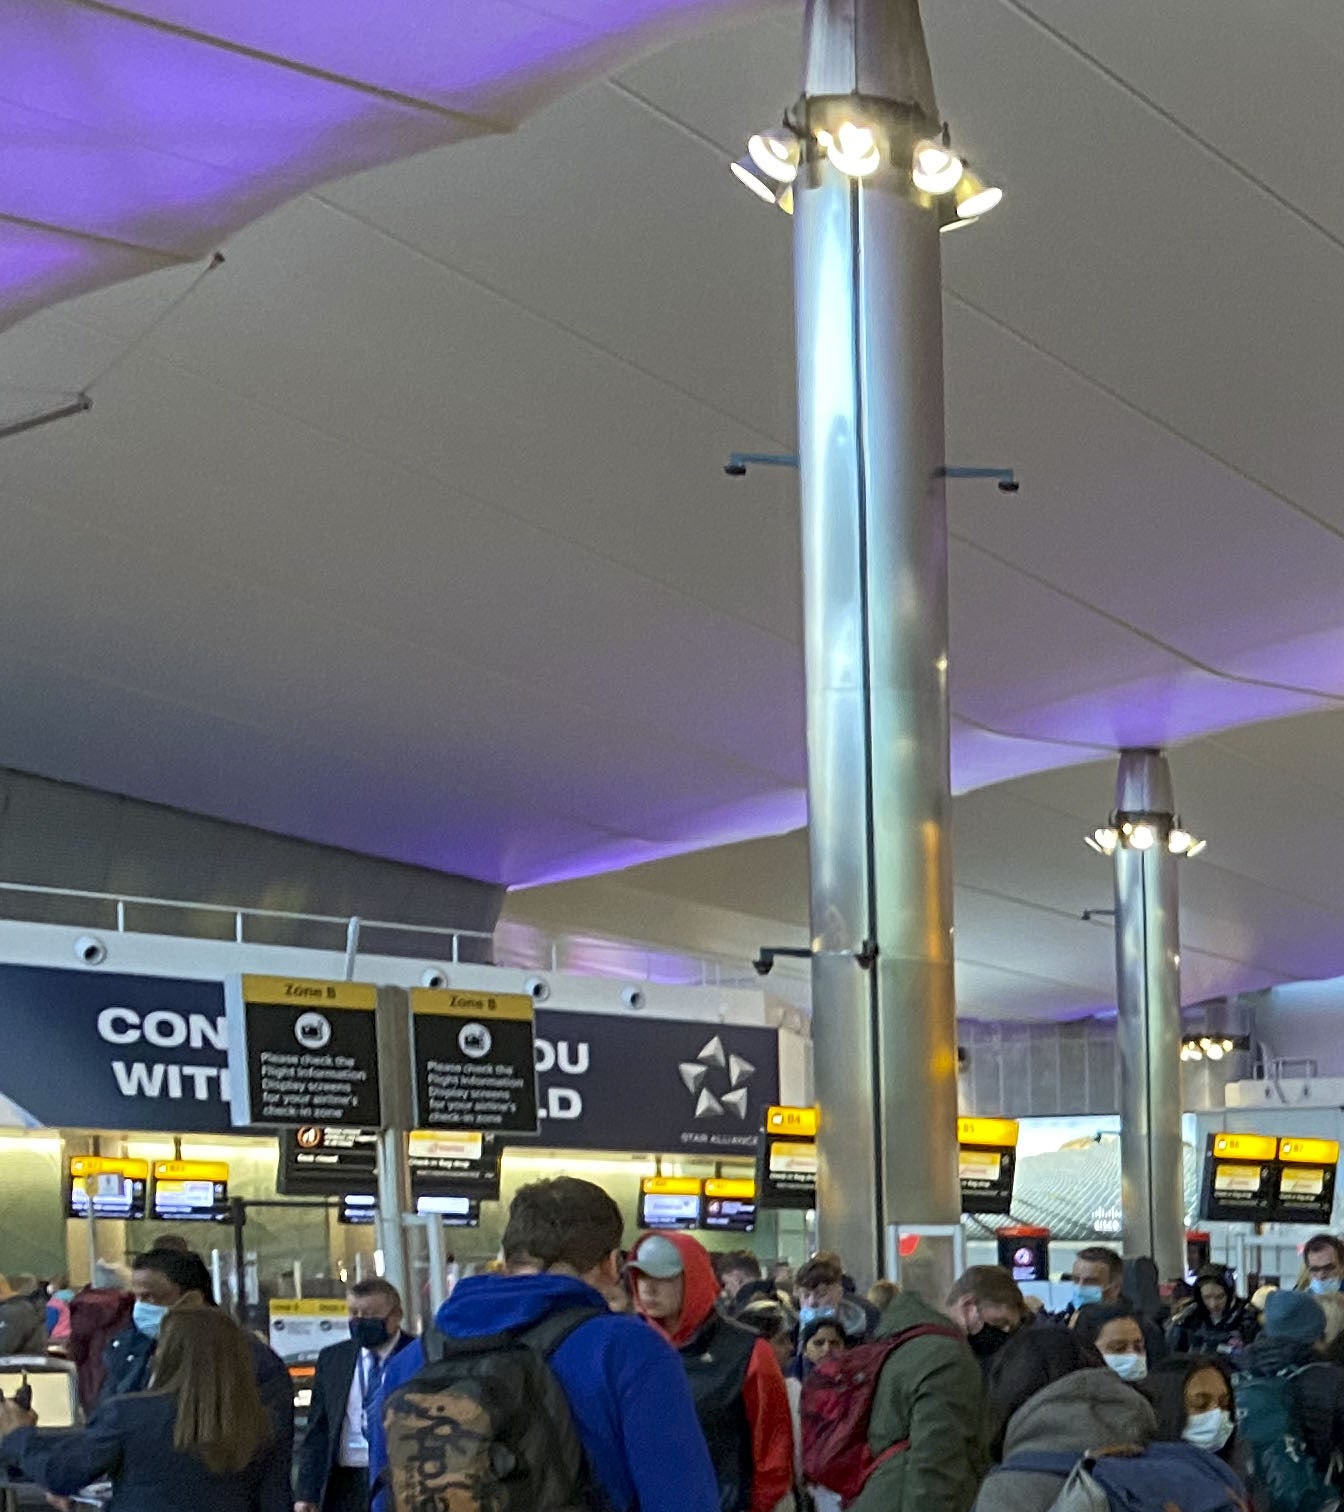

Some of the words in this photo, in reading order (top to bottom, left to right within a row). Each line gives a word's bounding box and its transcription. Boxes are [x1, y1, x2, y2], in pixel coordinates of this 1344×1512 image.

[284, 983, 323, 997] Zone
[450, 995, 484, 1010] Zone
[97, 1006, 228, 1050] CON
[261, 1051, 298, 1065] Please
[300, 1052, 334, 1066] check
[335, 1053, 355, 1067] the
[427, 1060, 462, 1073] Please
[463, 1061, 493, 1074] check
[495, 1062, 514, 1075] the
[307, 1081, 351, 1093] screens
[470, 1088, 510, 1100] screens
[263, 1092, 280, 1104] for
[282, 1094, 311, 1106] your
[429, 1098, 445, 1111] for
[447, 1101, 473, 1113] your
[263, 1105, 312, 1118] check-in
[314, 1107, 344, 1119] zone
[429, 1112, 473, 1123] check-in
[475, 1113, 502, 1123] zone
[680, 1132, 708, 1144] STAR
[709, 1134, 759, 1146] ALLIANCE
